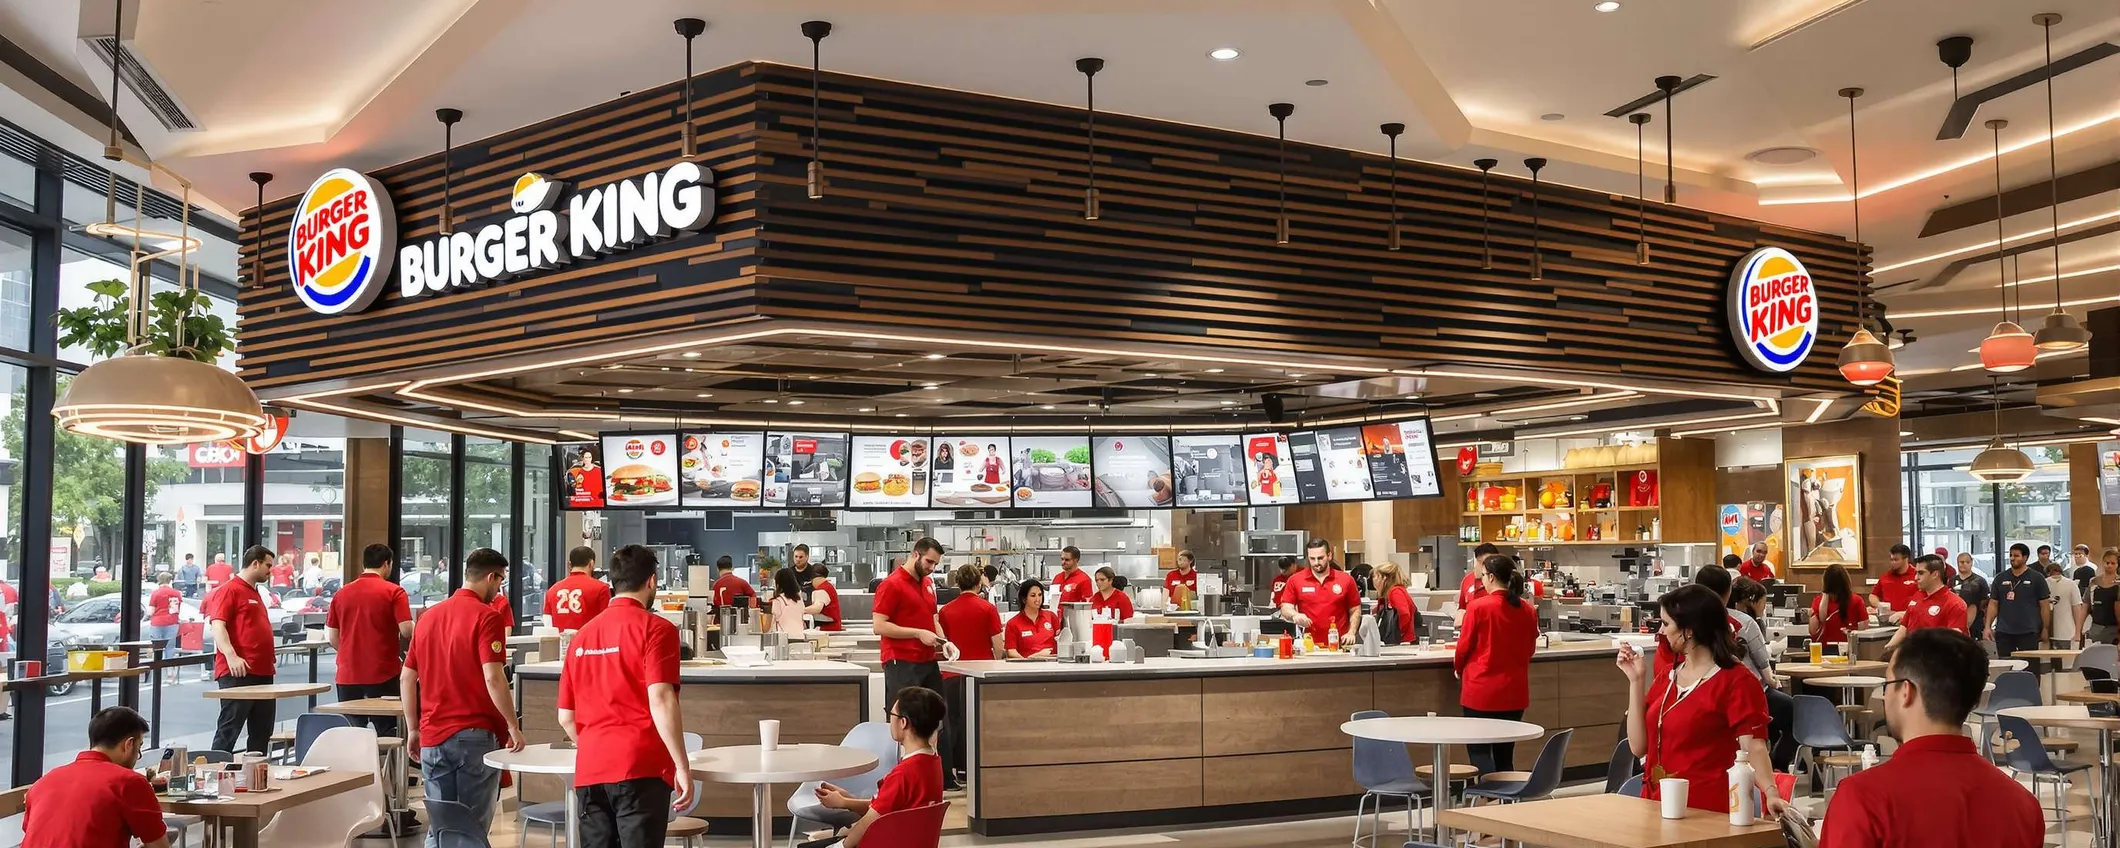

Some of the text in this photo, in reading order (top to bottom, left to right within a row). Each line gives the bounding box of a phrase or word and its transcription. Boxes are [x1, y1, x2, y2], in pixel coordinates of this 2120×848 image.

[296, 190, 367, 251] BURGER
[298, 213, 370, 287] KING
[399, 161, 708, 298] BURGER KING
[1750, 274, 1809, 308] BURGER
[1751, 294, 1812, 343] KING
